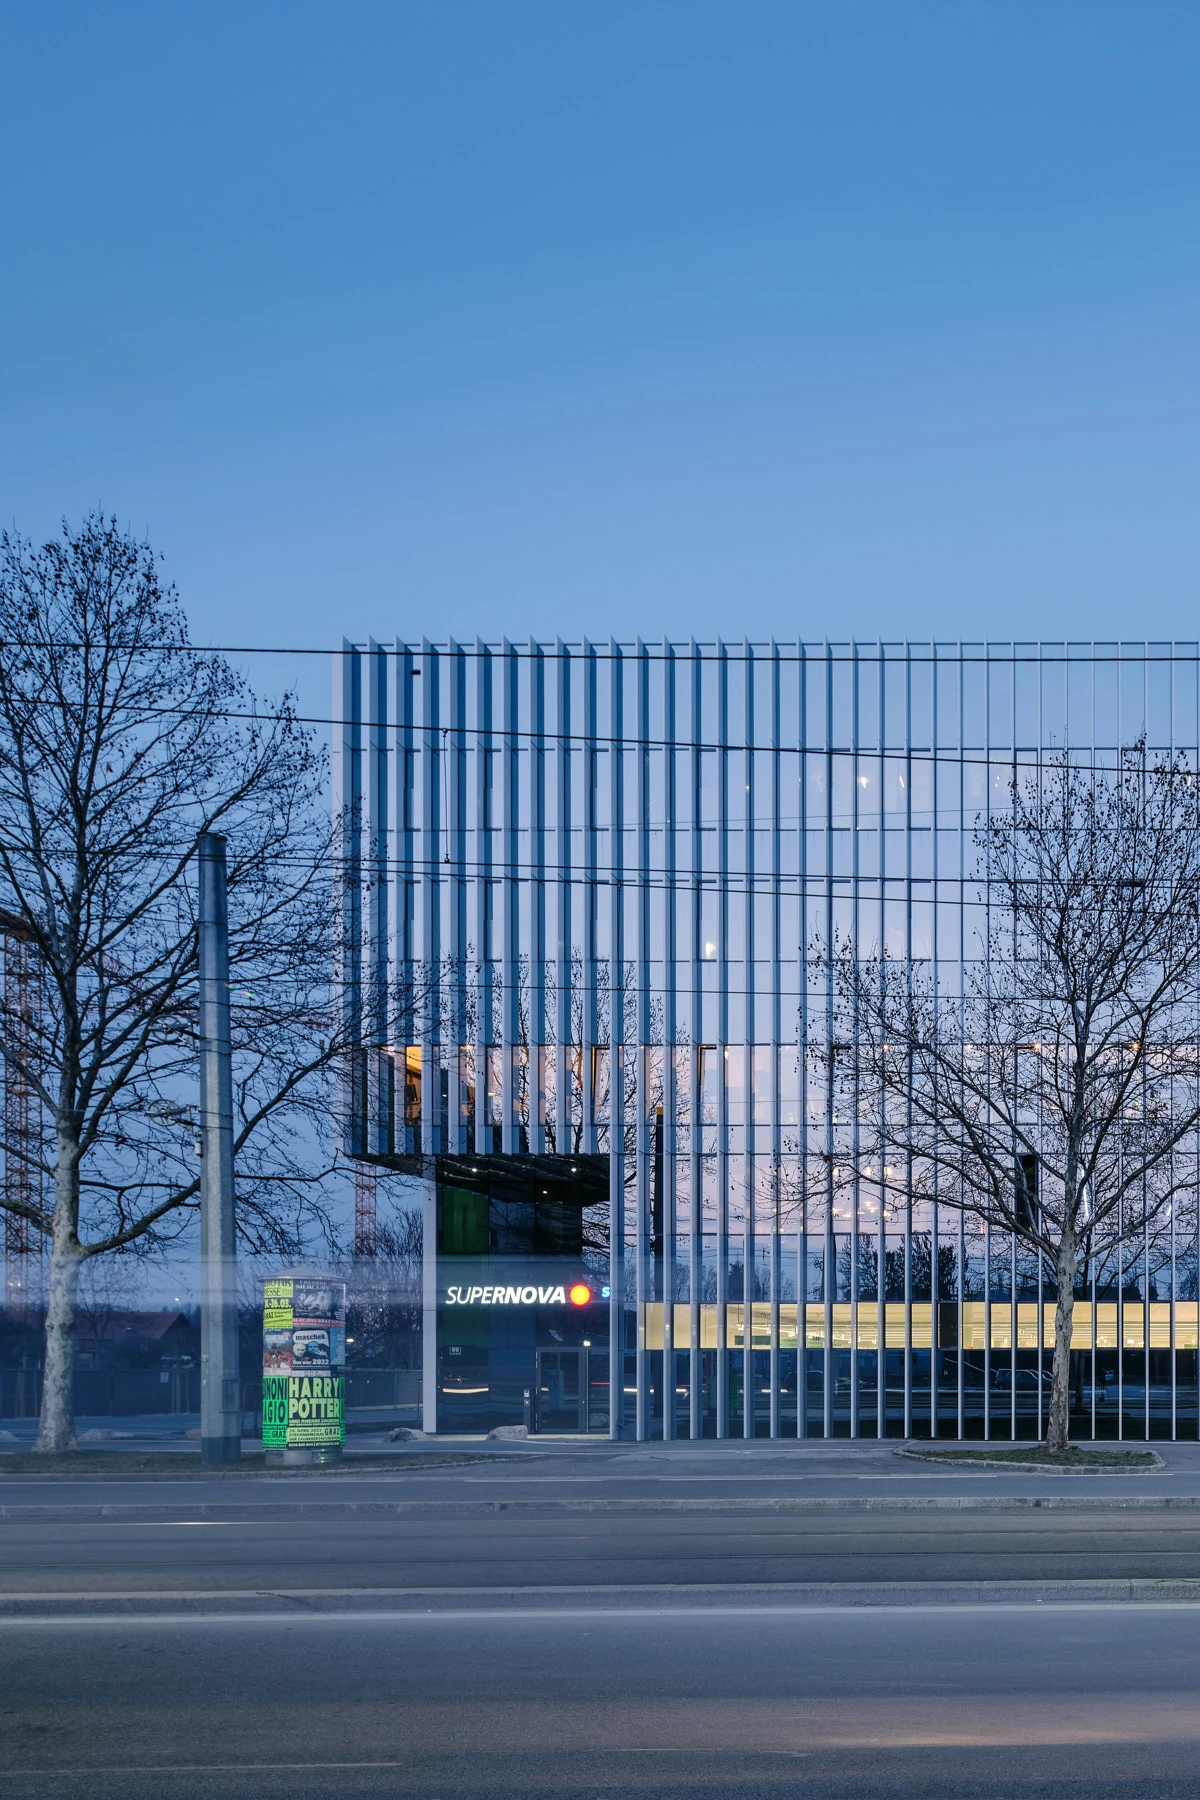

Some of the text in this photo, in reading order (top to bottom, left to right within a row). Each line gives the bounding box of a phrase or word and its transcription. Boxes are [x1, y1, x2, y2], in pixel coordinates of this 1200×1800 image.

[445, 1286, 566, 1305] SUPERNOVA
[289, 1377, 339, 1398] HARRY
[289, 1398, 340, 1418] POTTER
[324, 1428, 340, 1436] GRAZ
